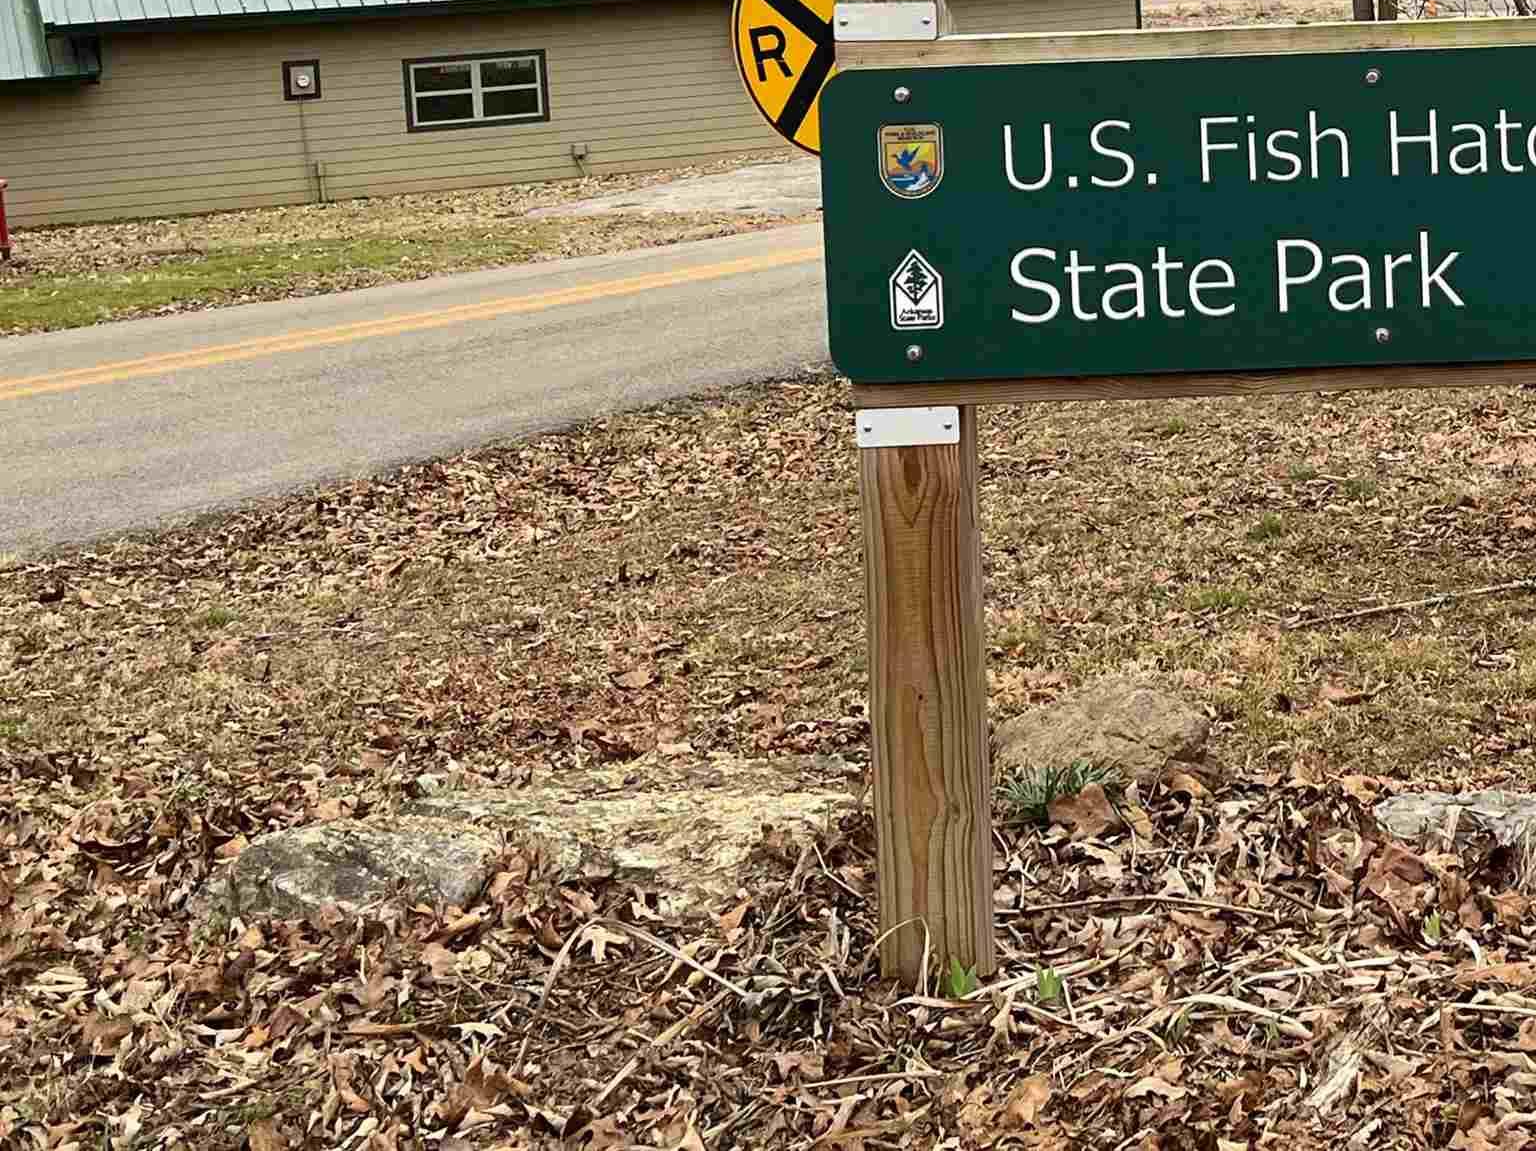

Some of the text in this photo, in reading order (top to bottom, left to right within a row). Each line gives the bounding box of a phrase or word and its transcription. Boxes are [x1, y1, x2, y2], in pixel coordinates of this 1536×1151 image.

[748, 25, 794, 82] R
[1002, 119, 1158, 192] U.S.
[1199, 109, 1350, 184] Fish
[1009, 230, 1466, 324] State Park
